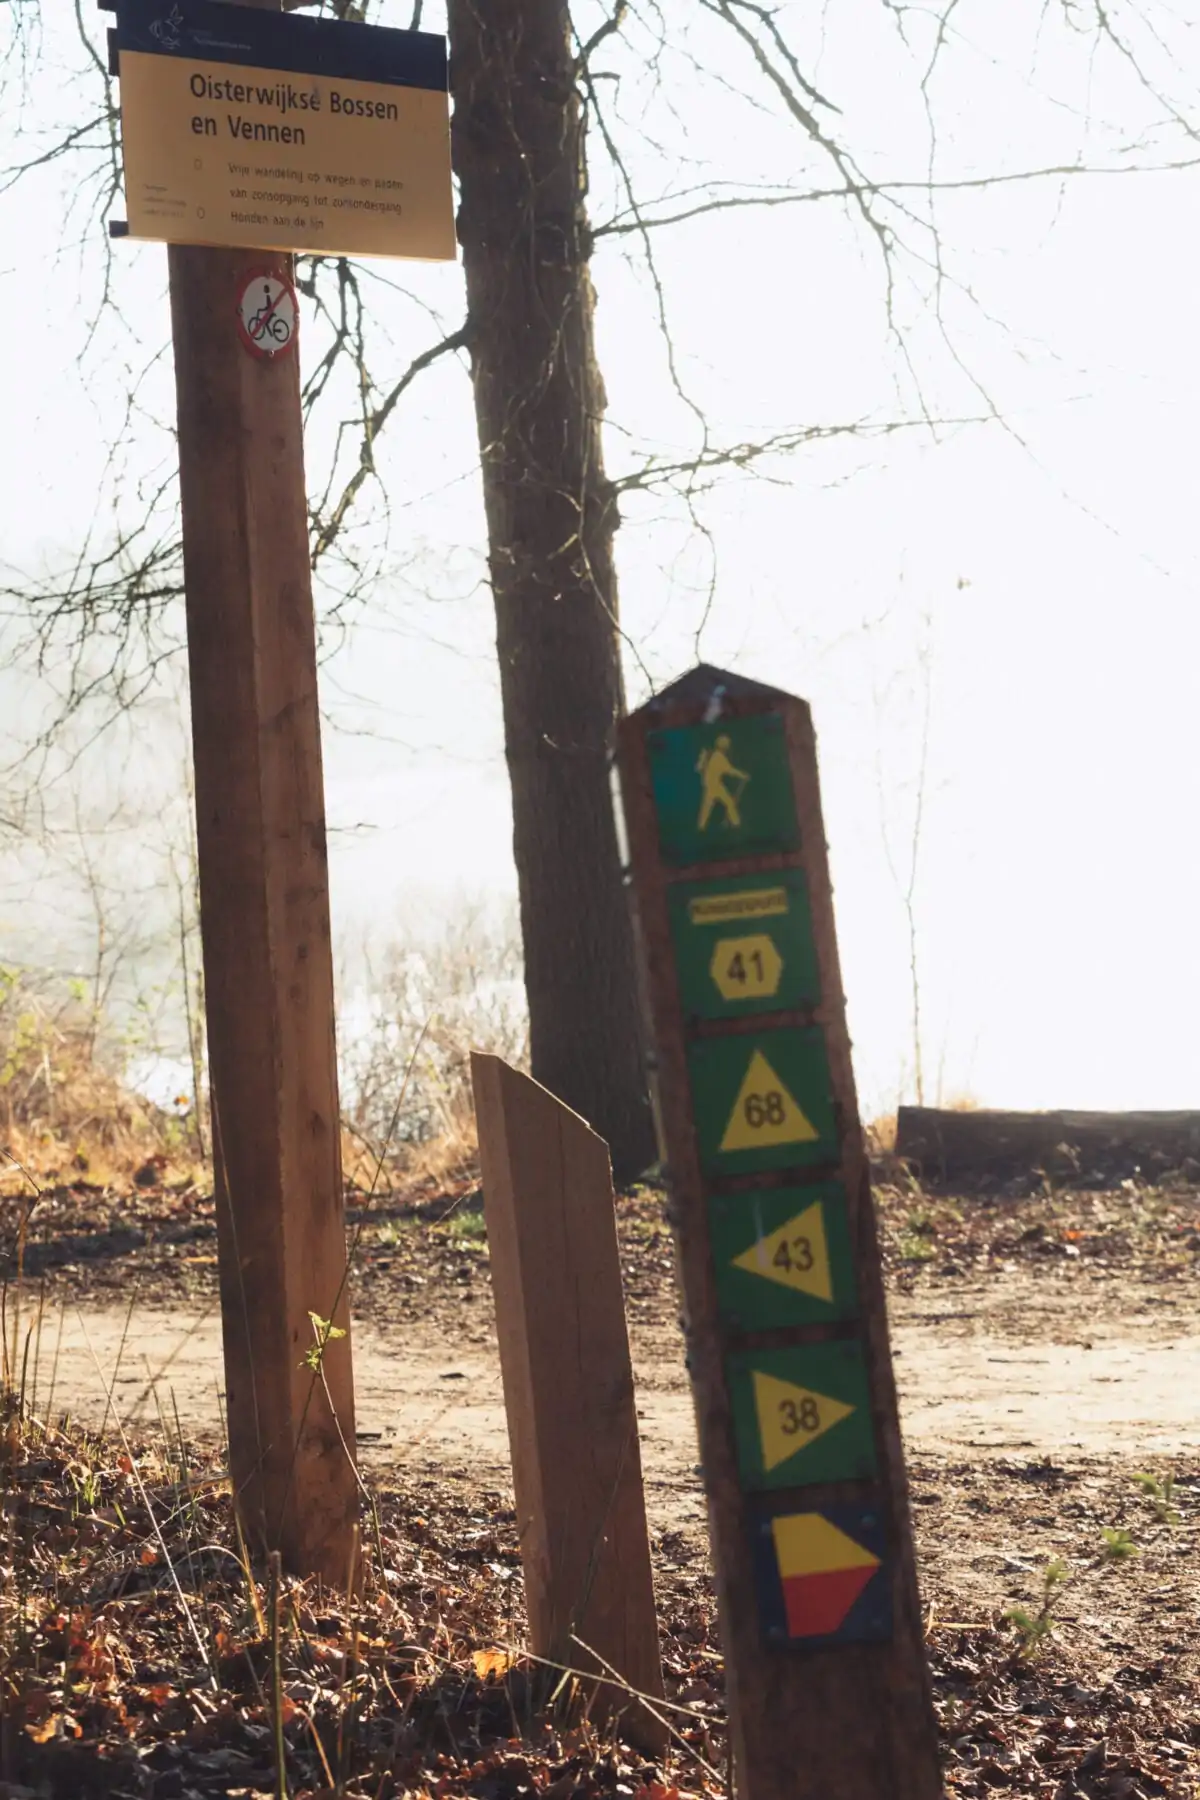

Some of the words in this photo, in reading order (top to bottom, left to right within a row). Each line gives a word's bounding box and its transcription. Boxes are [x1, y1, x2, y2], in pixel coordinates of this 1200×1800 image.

[190, 74, 321, 114] Oisterwijkse
[330, 91, 399, 121] Bossen
[191, 115, 217, 136] en
[227, 114, 305, 145] Vennen
[255, 166, 303, 184] wandeling
[307, 172, 320, 184] op
[324, 174, 355, 187] wegen
[229, 187, 247, 198] van
[252, 190, 309, 207] zonsopgang
[314, 195, 328, 205] tot
[333, 196, 402, 216] zonsondergang
[231, 210, 268, 224] Honden
[273, 215, 290, 226] aan
[293, 215, 306, 227] de
[726, 948, 764, 984] 41
[744, 1090, 786, 1128] 68
[772, 1236, 815, 1274] 43
[777, 1396, 820, 1436] 38
